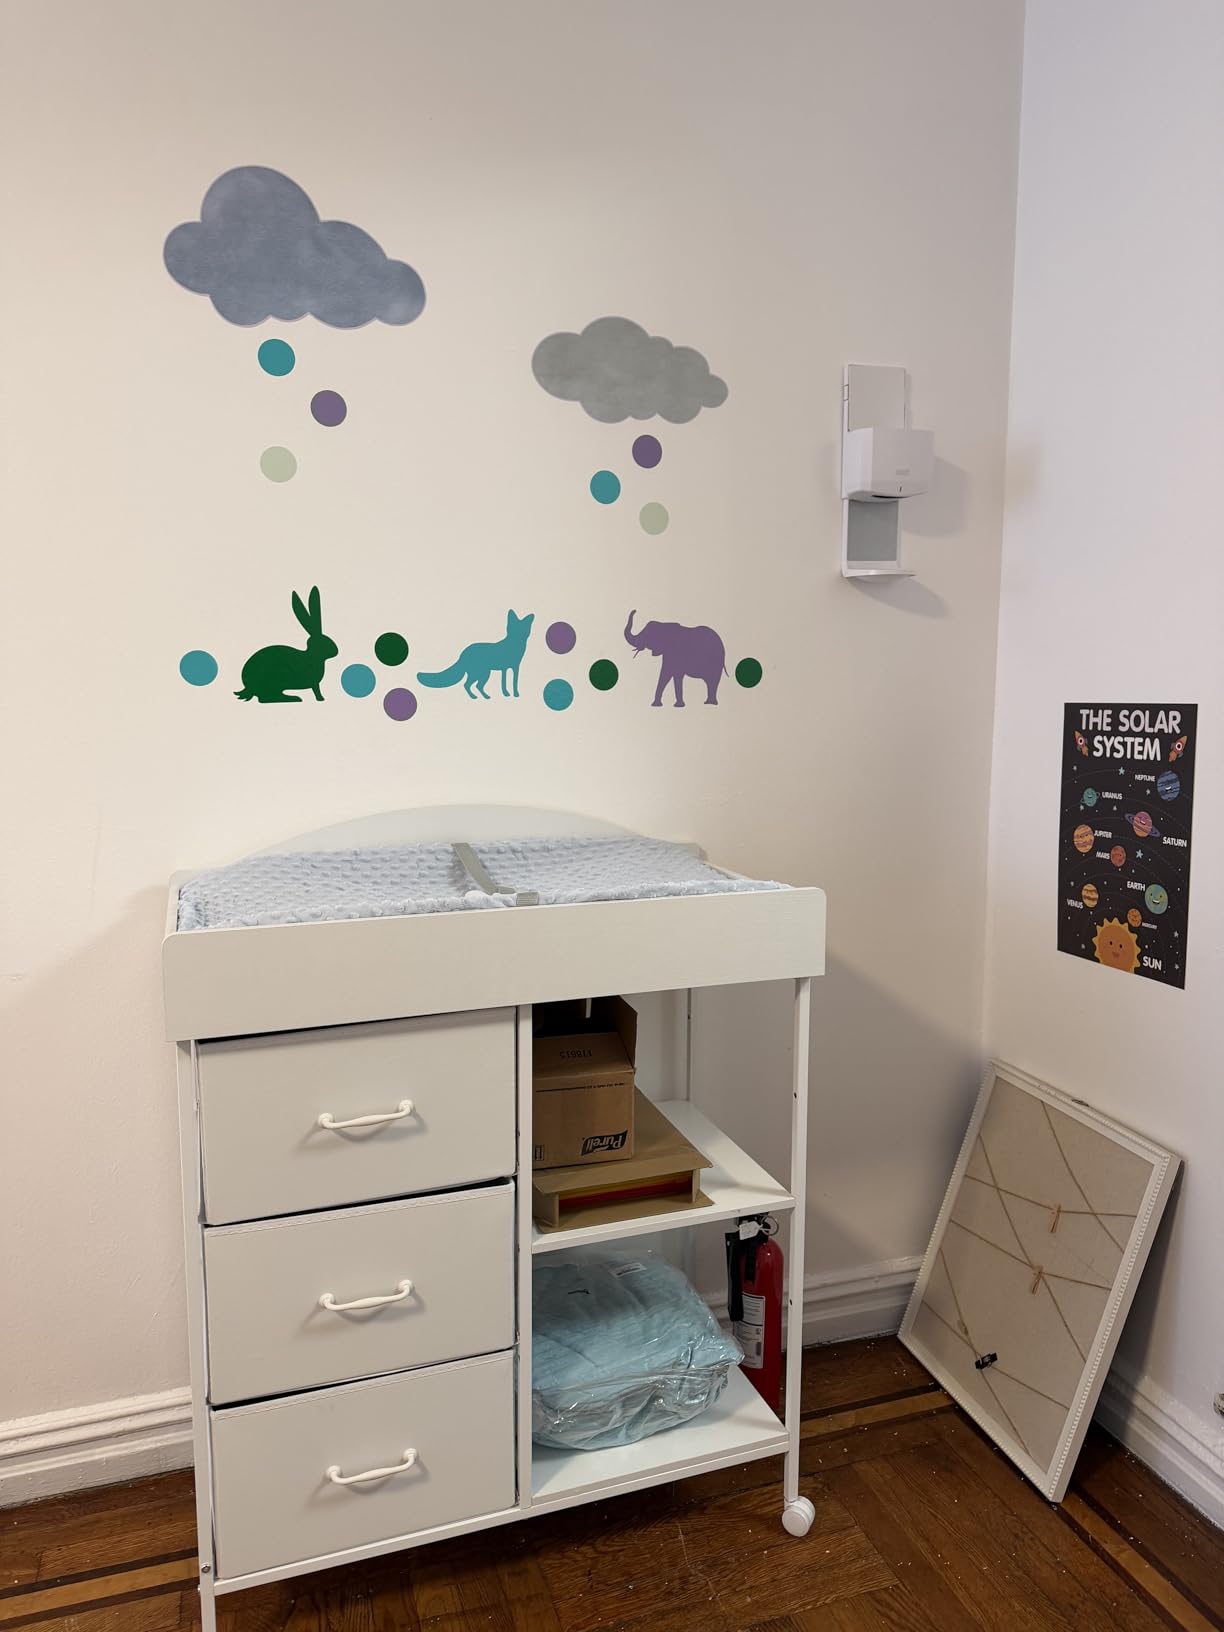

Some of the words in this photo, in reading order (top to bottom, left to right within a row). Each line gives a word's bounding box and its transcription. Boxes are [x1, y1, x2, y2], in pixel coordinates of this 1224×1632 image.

[1080, 709, 1112, 731] THE
[1119, 710, 1181, 733] SOLAR
[1093, 735, 1161, 761] SYSTEM
[1135, 774, 1156, 782] NEPTUNE
[1102, 791, 1123, 800] URANUS
[1163, 837, 1187, 847] SATURN
[1127, 881, 1146, 891] EARTH
[1143, 956, 1162, 971] SUN
[585, 1134, 624, 1152] Purell
